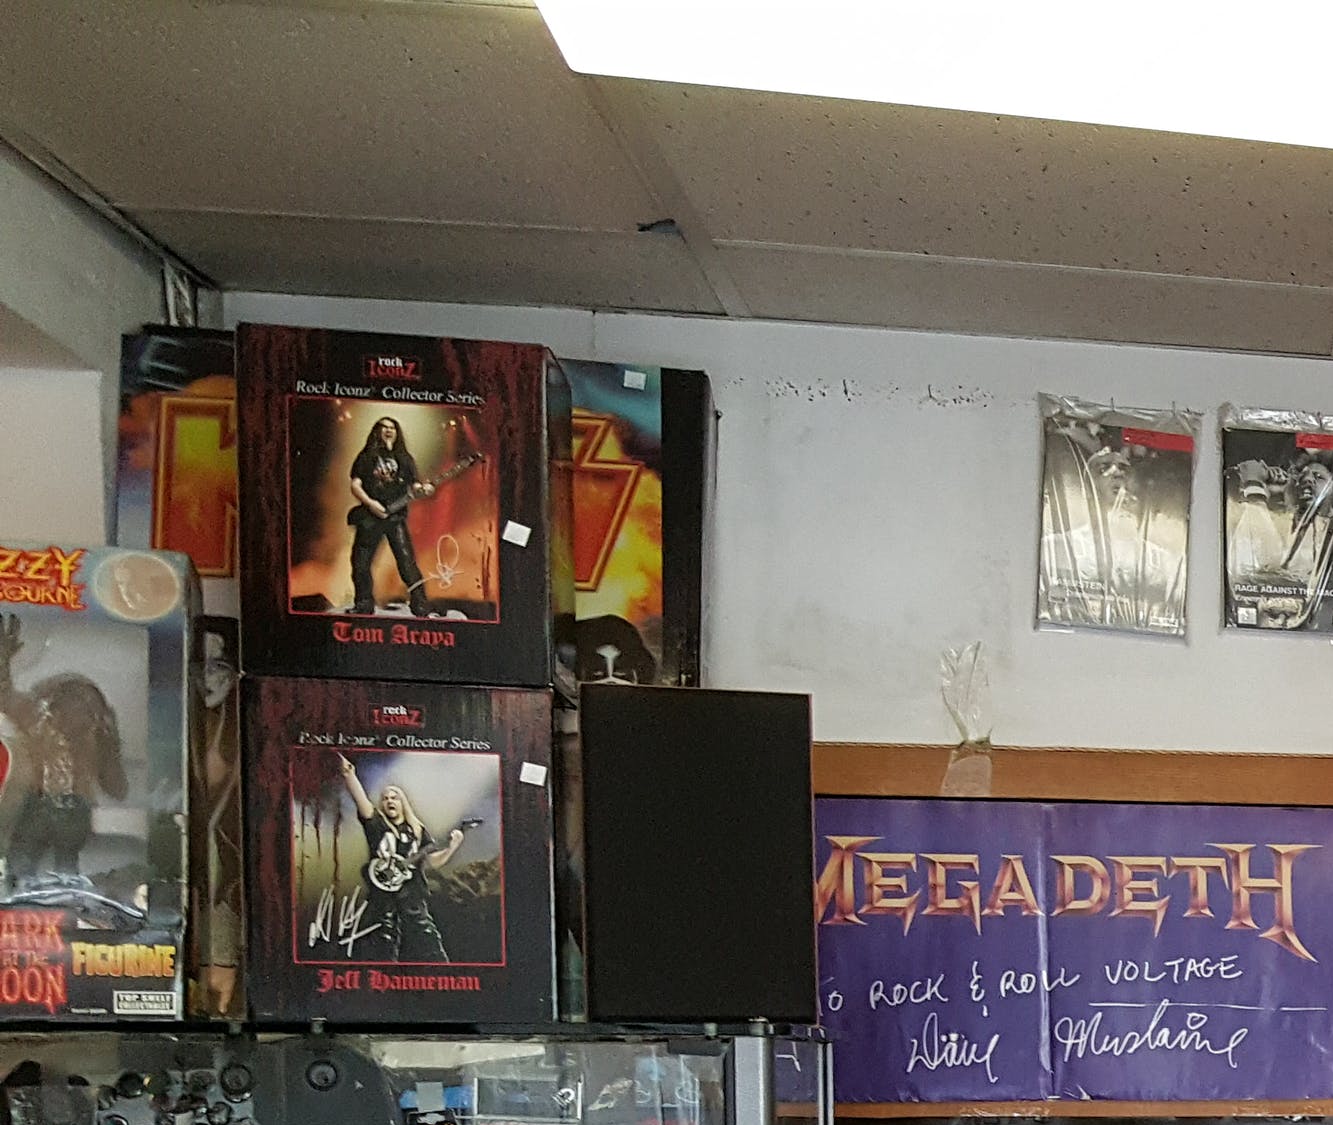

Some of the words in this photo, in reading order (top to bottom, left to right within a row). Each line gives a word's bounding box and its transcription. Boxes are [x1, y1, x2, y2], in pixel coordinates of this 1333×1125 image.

[296, 380, 330, 395] Rock
[382, 386, 443, 402] Collector
[446, 390, 487, 406] Series
[0, 584, 88, 610] OURNE
[1235, 584, 1258, 593] RAGE
[1261, 585, 1297, 595] AGAINST
[332, 621, 384, 645] Tom
[391, 624, 456, 648] Araya
[386, 735, 448, 749] Collector
[450, 737, 492, 751] Series
[317, 969, 361, 993] Jeff
[368, 969, 482, 992] Hanneman
[869, 973, 949, 1008] ROCK
[1000, 966, 1081, 998] ROLL
[1104, 953, 1246, 985] VOLTAGE
